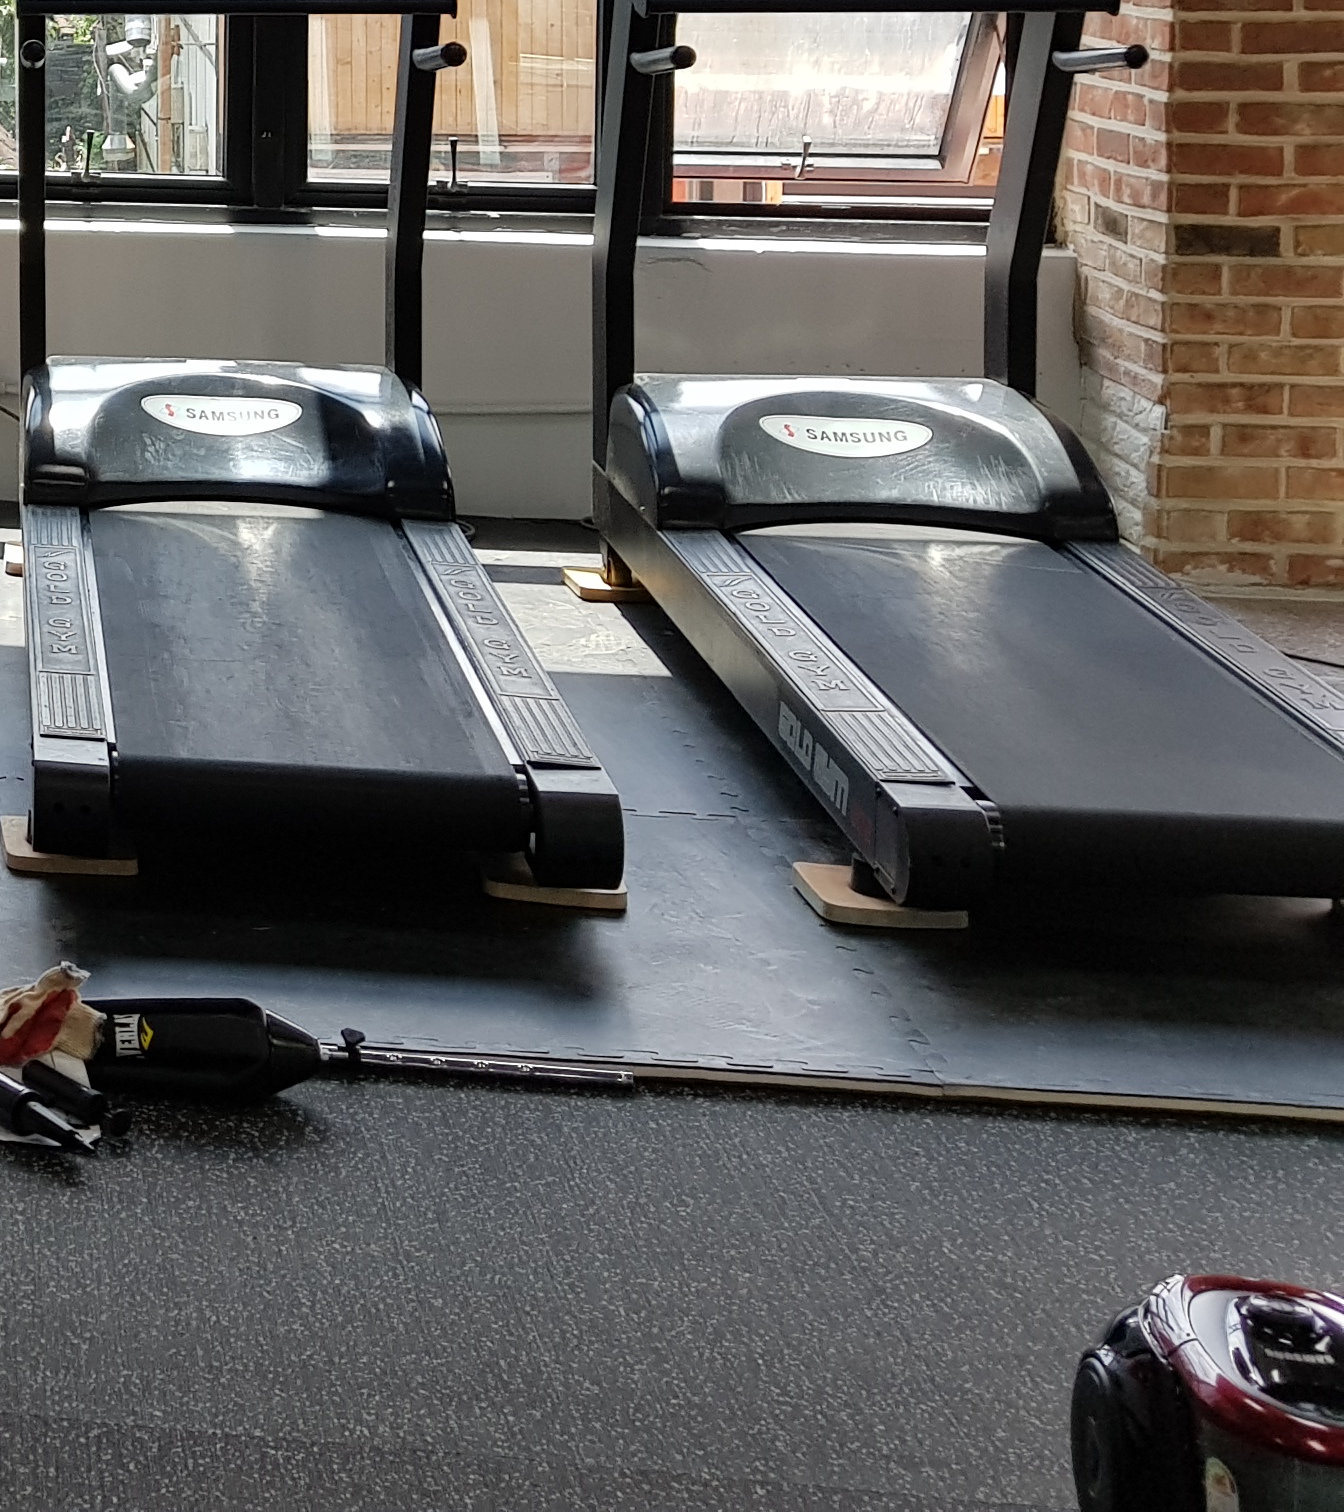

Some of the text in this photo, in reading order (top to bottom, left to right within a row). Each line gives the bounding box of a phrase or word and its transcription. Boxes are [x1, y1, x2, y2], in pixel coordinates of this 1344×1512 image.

[185, 407, 280, 422] SAMSUNG
[805, 428, 909, 444] SAMSUNG
[43, 560, 78, 654] GOLD GYM
[450, 579, 532, 679] GOLD GYM
[731, 589, 850, 691] GOLD GYM
